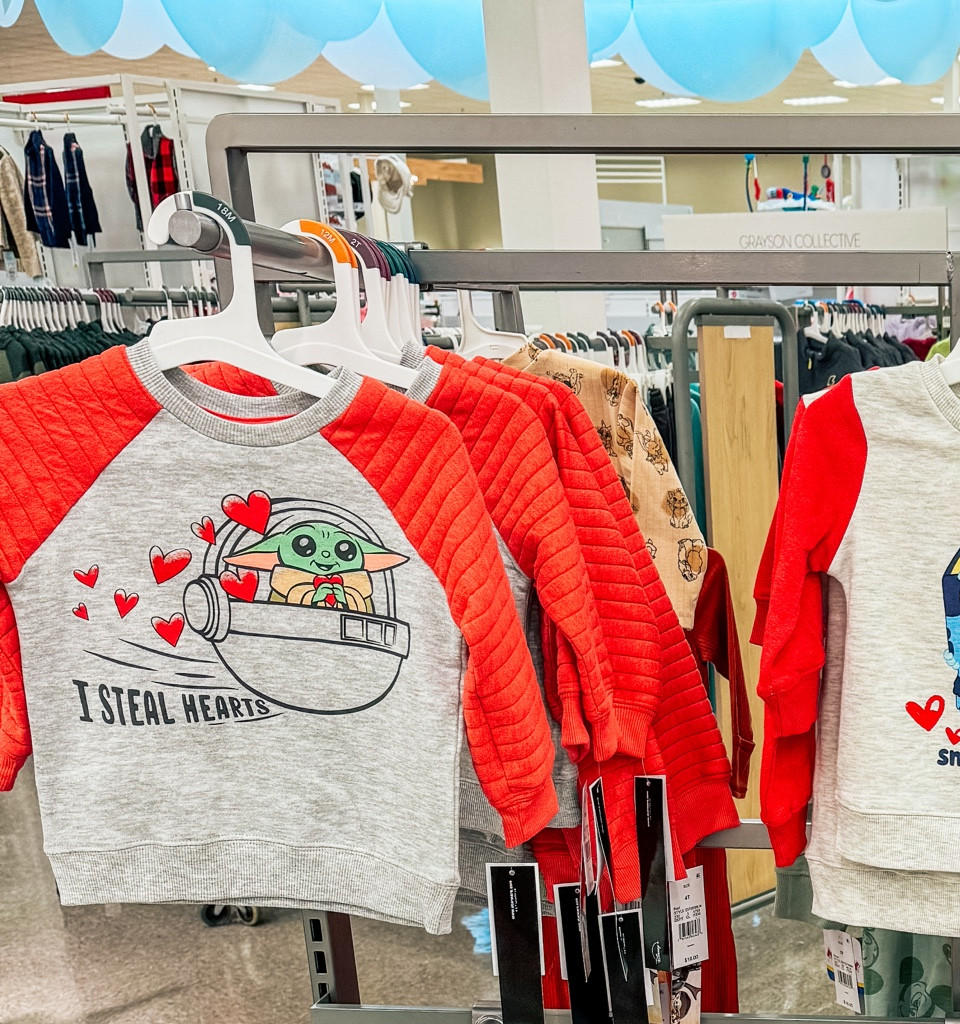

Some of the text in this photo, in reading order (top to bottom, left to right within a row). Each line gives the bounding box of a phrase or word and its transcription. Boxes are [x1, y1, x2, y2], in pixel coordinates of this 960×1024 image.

[216, 203, 237, 224] 18M
[319, 228, 336, 244] 12M
[350, 237, 362, 248] 2T
[738, 232, 861, 250] GRAYSON COLLECTIVE
[72, 679, 270, 726] I STEAL HEARTS
